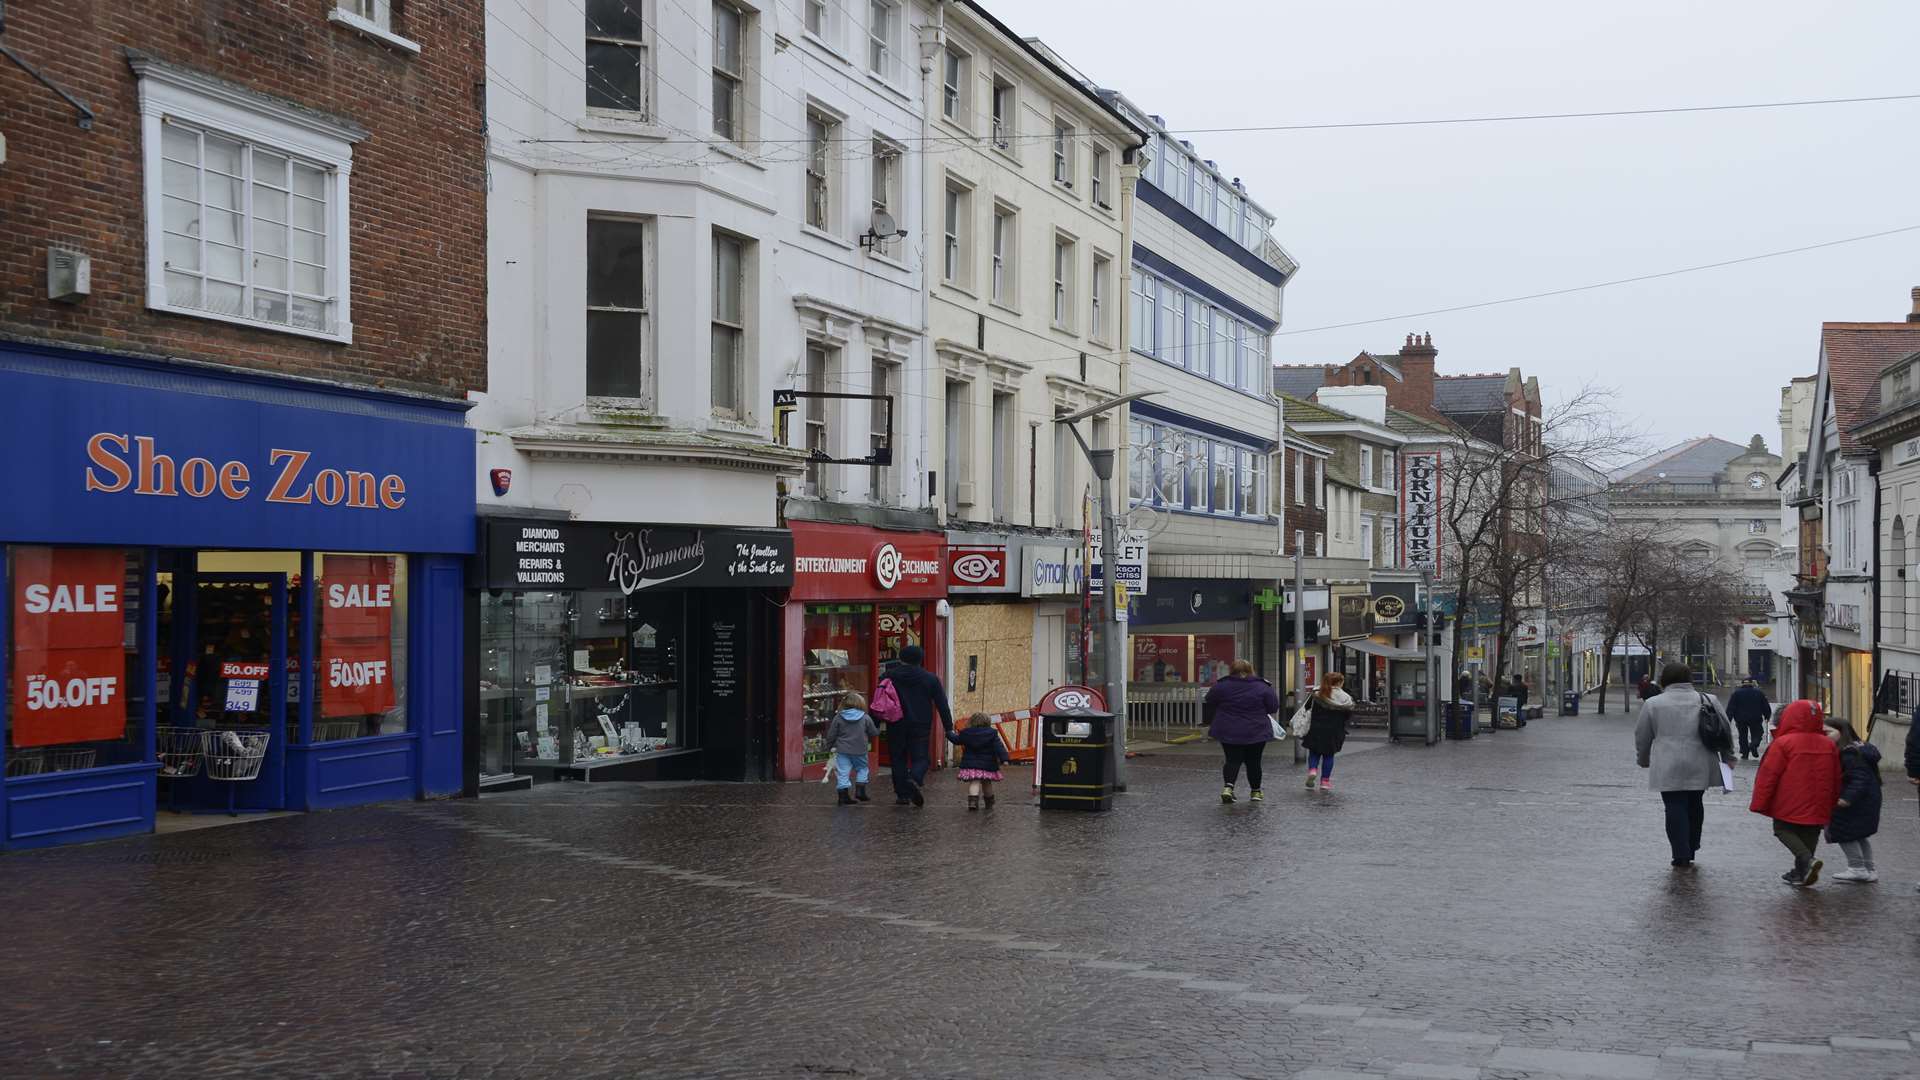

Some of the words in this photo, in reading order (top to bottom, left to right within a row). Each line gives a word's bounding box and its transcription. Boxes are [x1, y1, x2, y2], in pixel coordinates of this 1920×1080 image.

[86, 432, 250, 500] Shoe
[265, 449, 406, 510] Zone
[1409, 456, 1432, 562] FURNITURE
[522, 528, 560, 539] DIAMOND
[516, 541, 565, 552] MERCHANTS
[629, 529, 705, 575] Simmonds
[736, 543, 749, 557] The
[750, 543, 778, 560] Jewellers
[519, 558, 553, 569] REPAIRS
[555, 559, 562, 570] &
[728, 560, 736, 577] of
[737, 560, 747, 573] the
[748, 560, 768, 574] South
[769, 560, 785, 575] East
[795, 556, 867, 573] ENTERTAINMENT
[902, 559, 939, 575] EXCHANGE
[517, 571, 565, 583] VALUATIONS
[25, 584, 118, 613] SALE
[329, 583, 391, 608] SALE
[1136, 643, 1157, 654] 1/2
[225, 701, 250, 711] 349
